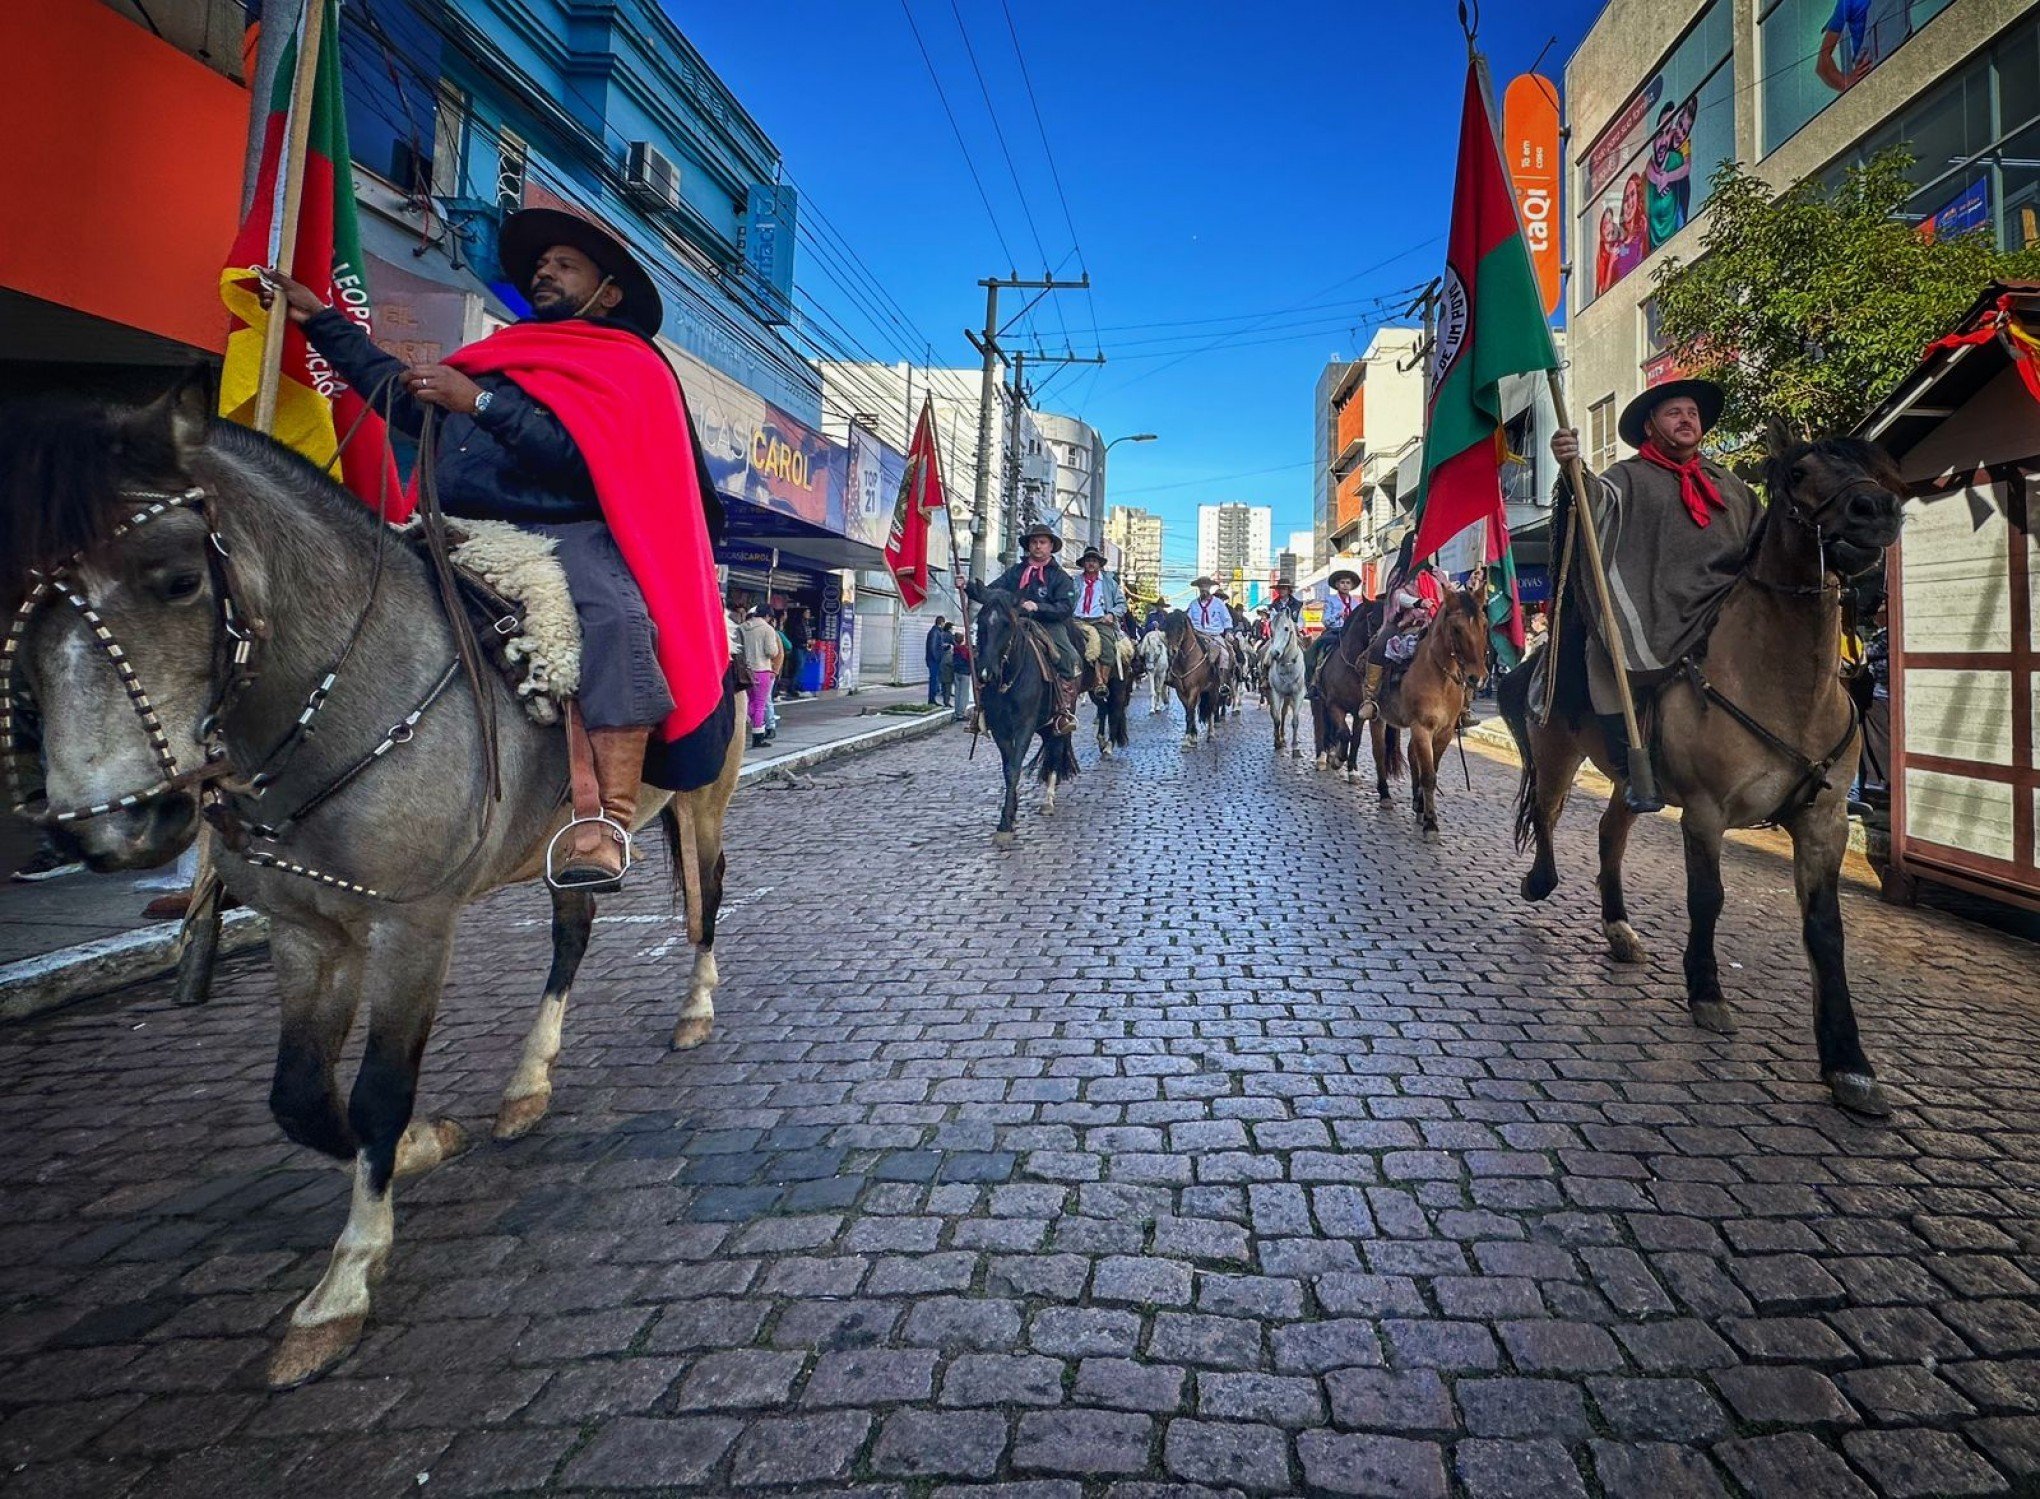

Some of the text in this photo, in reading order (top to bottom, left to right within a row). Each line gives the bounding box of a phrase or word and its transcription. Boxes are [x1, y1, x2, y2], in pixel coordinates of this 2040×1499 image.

[1446, 323, 1462, 346] UM
[752, 428, 813, 492] CAROL
[864, 469, 878, 488] TOP
[865, 489, 876, 513] 21
